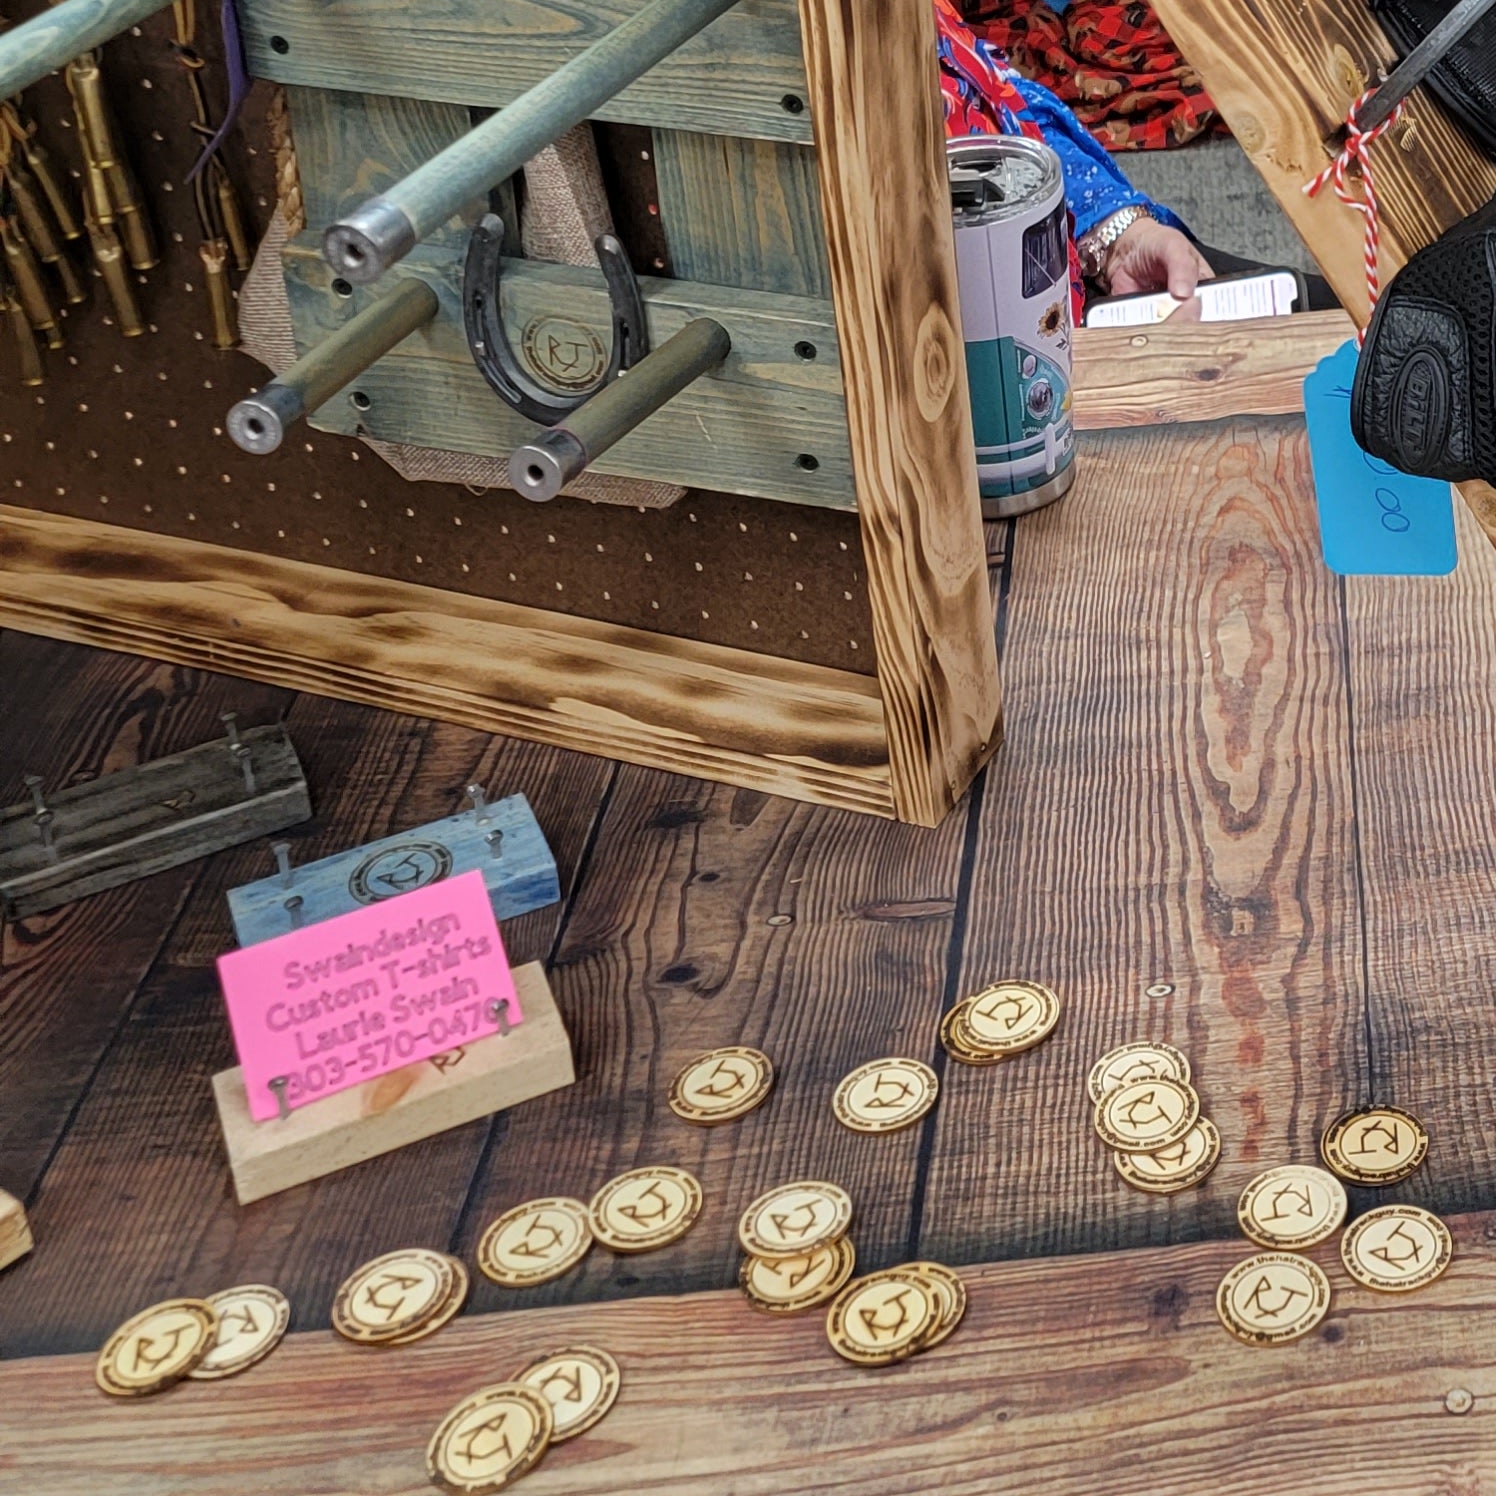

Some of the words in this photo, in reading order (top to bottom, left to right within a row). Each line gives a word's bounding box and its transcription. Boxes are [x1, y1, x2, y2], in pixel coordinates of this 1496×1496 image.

[265, 982, 379, 1032] Custom
[380, 935, 493, 990] T-shirts
[284, 911, 461, 990] Swaindesign
[294, 1009, 385, 1060] Laurie
[389, 974, 479, 1024] Swain
